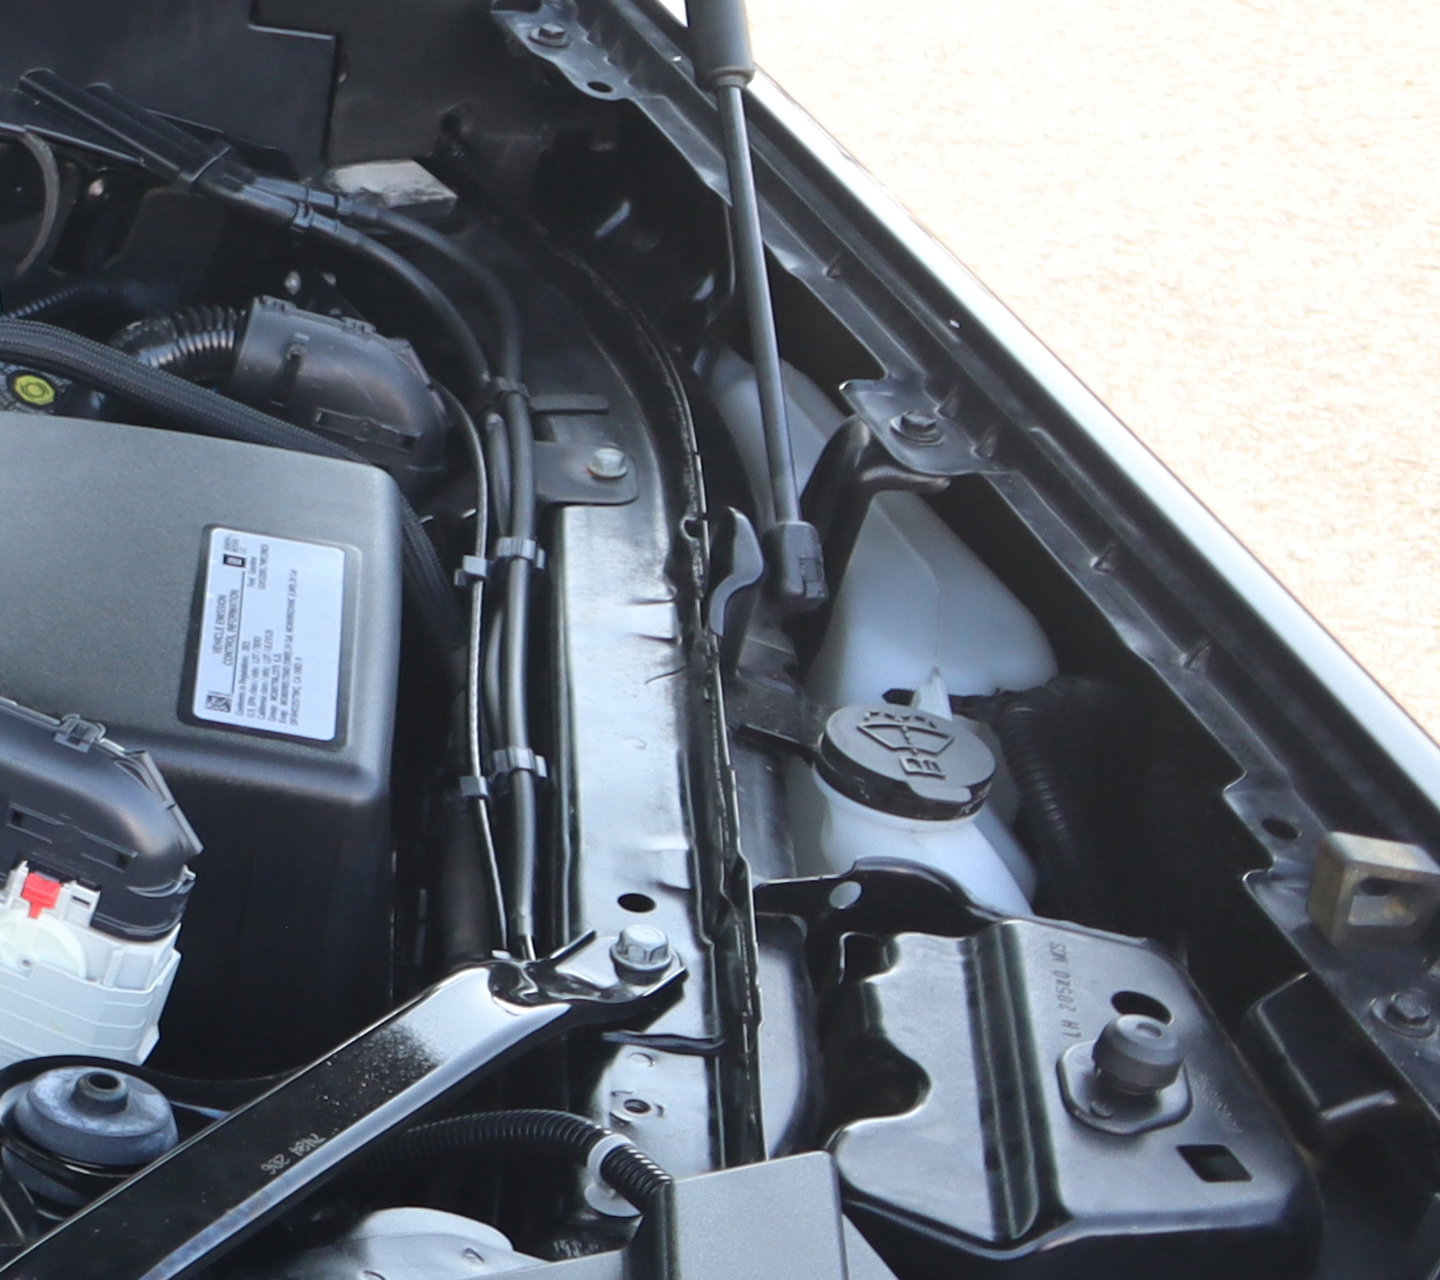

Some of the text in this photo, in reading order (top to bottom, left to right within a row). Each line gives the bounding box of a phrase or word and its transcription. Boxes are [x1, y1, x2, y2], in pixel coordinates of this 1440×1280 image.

[224, 588, 239, 666] CONTROL INFORMATION
[1062, 1019, 1082, 1038] LH
